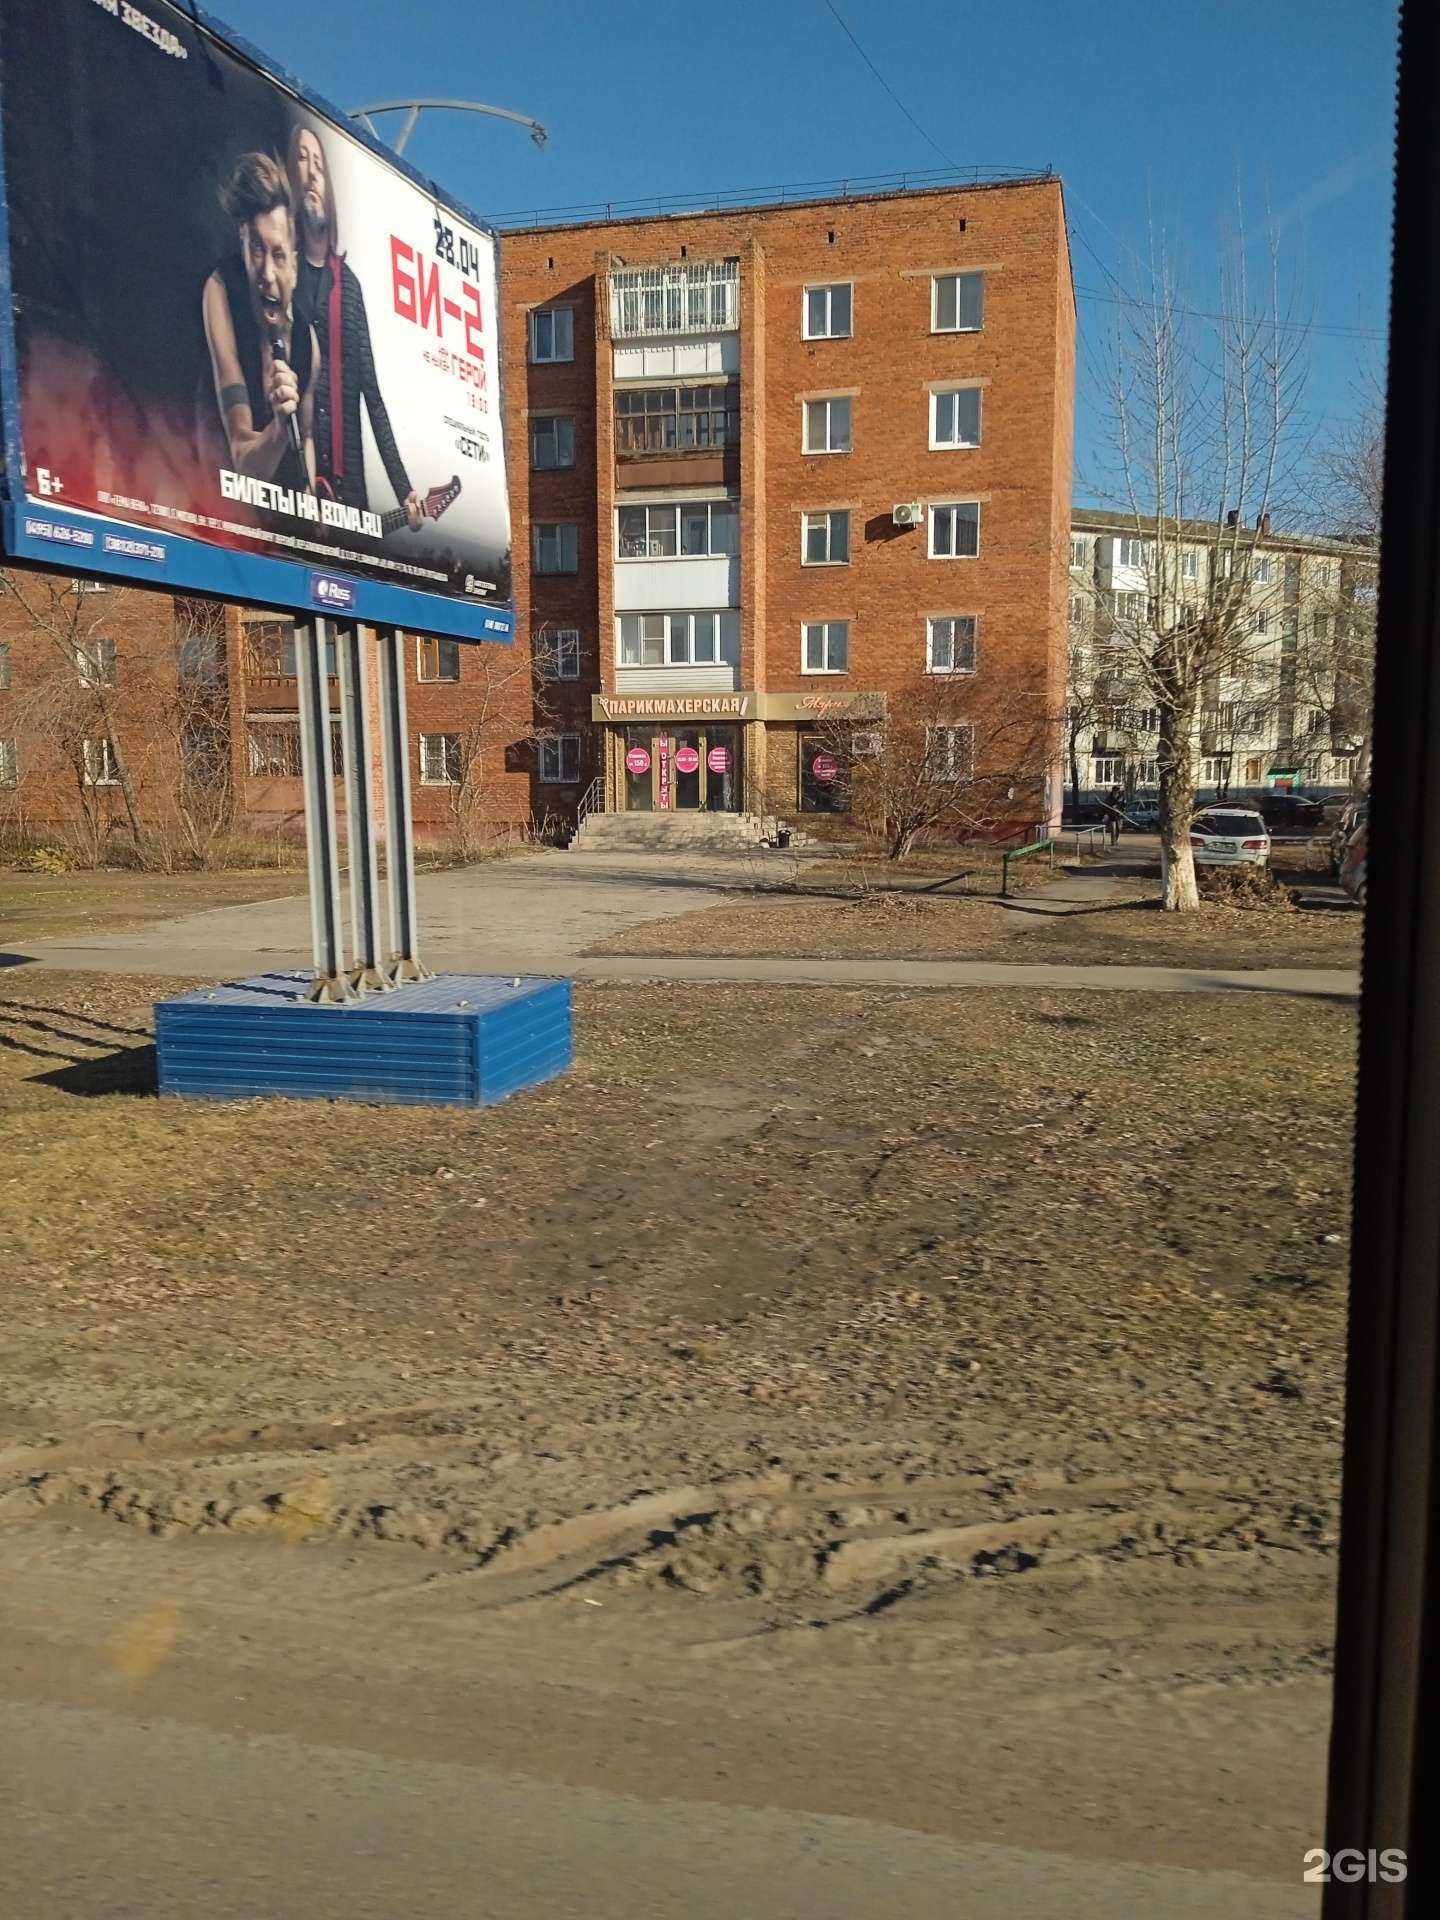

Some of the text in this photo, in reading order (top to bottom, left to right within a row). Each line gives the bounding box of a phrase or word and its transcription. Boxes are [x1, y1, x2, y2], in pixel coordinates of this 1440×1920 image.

[433, 219, 479, 282] 28.04
[390, 234, 484, 361] БИ-2
[36, 467, 64, 496] 6+
[219, 469, 295, 515] БИЛЕТЫ
[296, 491, 320, 522] НА
[609, 697, 739, 714] ПАРИКМАХЕРСКАЯ
